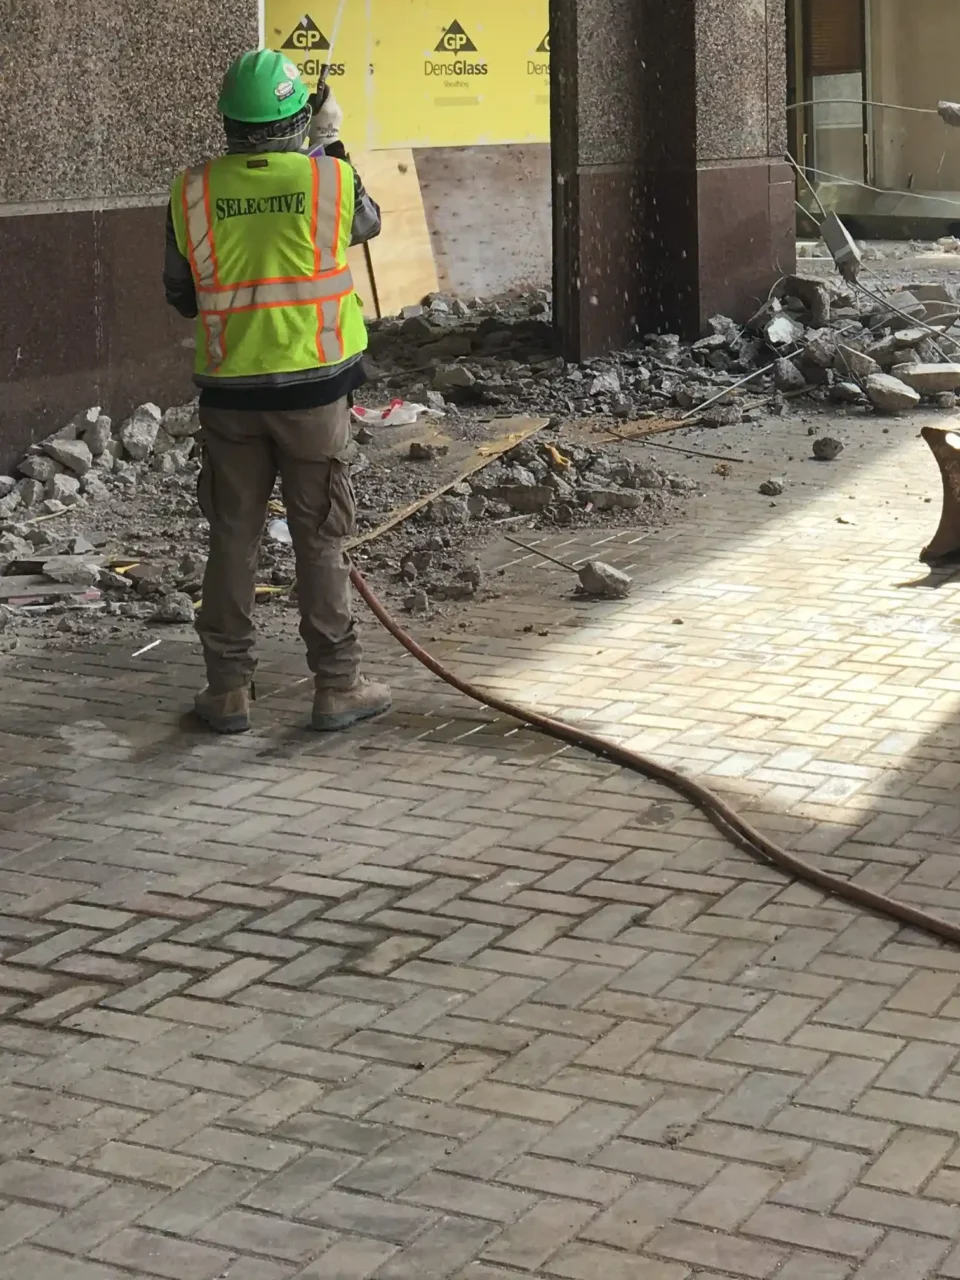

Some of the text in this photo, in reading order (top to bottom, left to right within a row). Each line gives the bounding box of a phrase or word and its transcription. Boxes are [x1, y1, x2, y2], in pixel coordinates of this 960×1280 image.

[292, 29, 321, 48] GP
[443, 33, 467, 50] GP
[297, 59, 345, 76] sGlss
[424, 59, 489, 77] DensGlass
[215, 190, 307, 222] SELECTIVE
